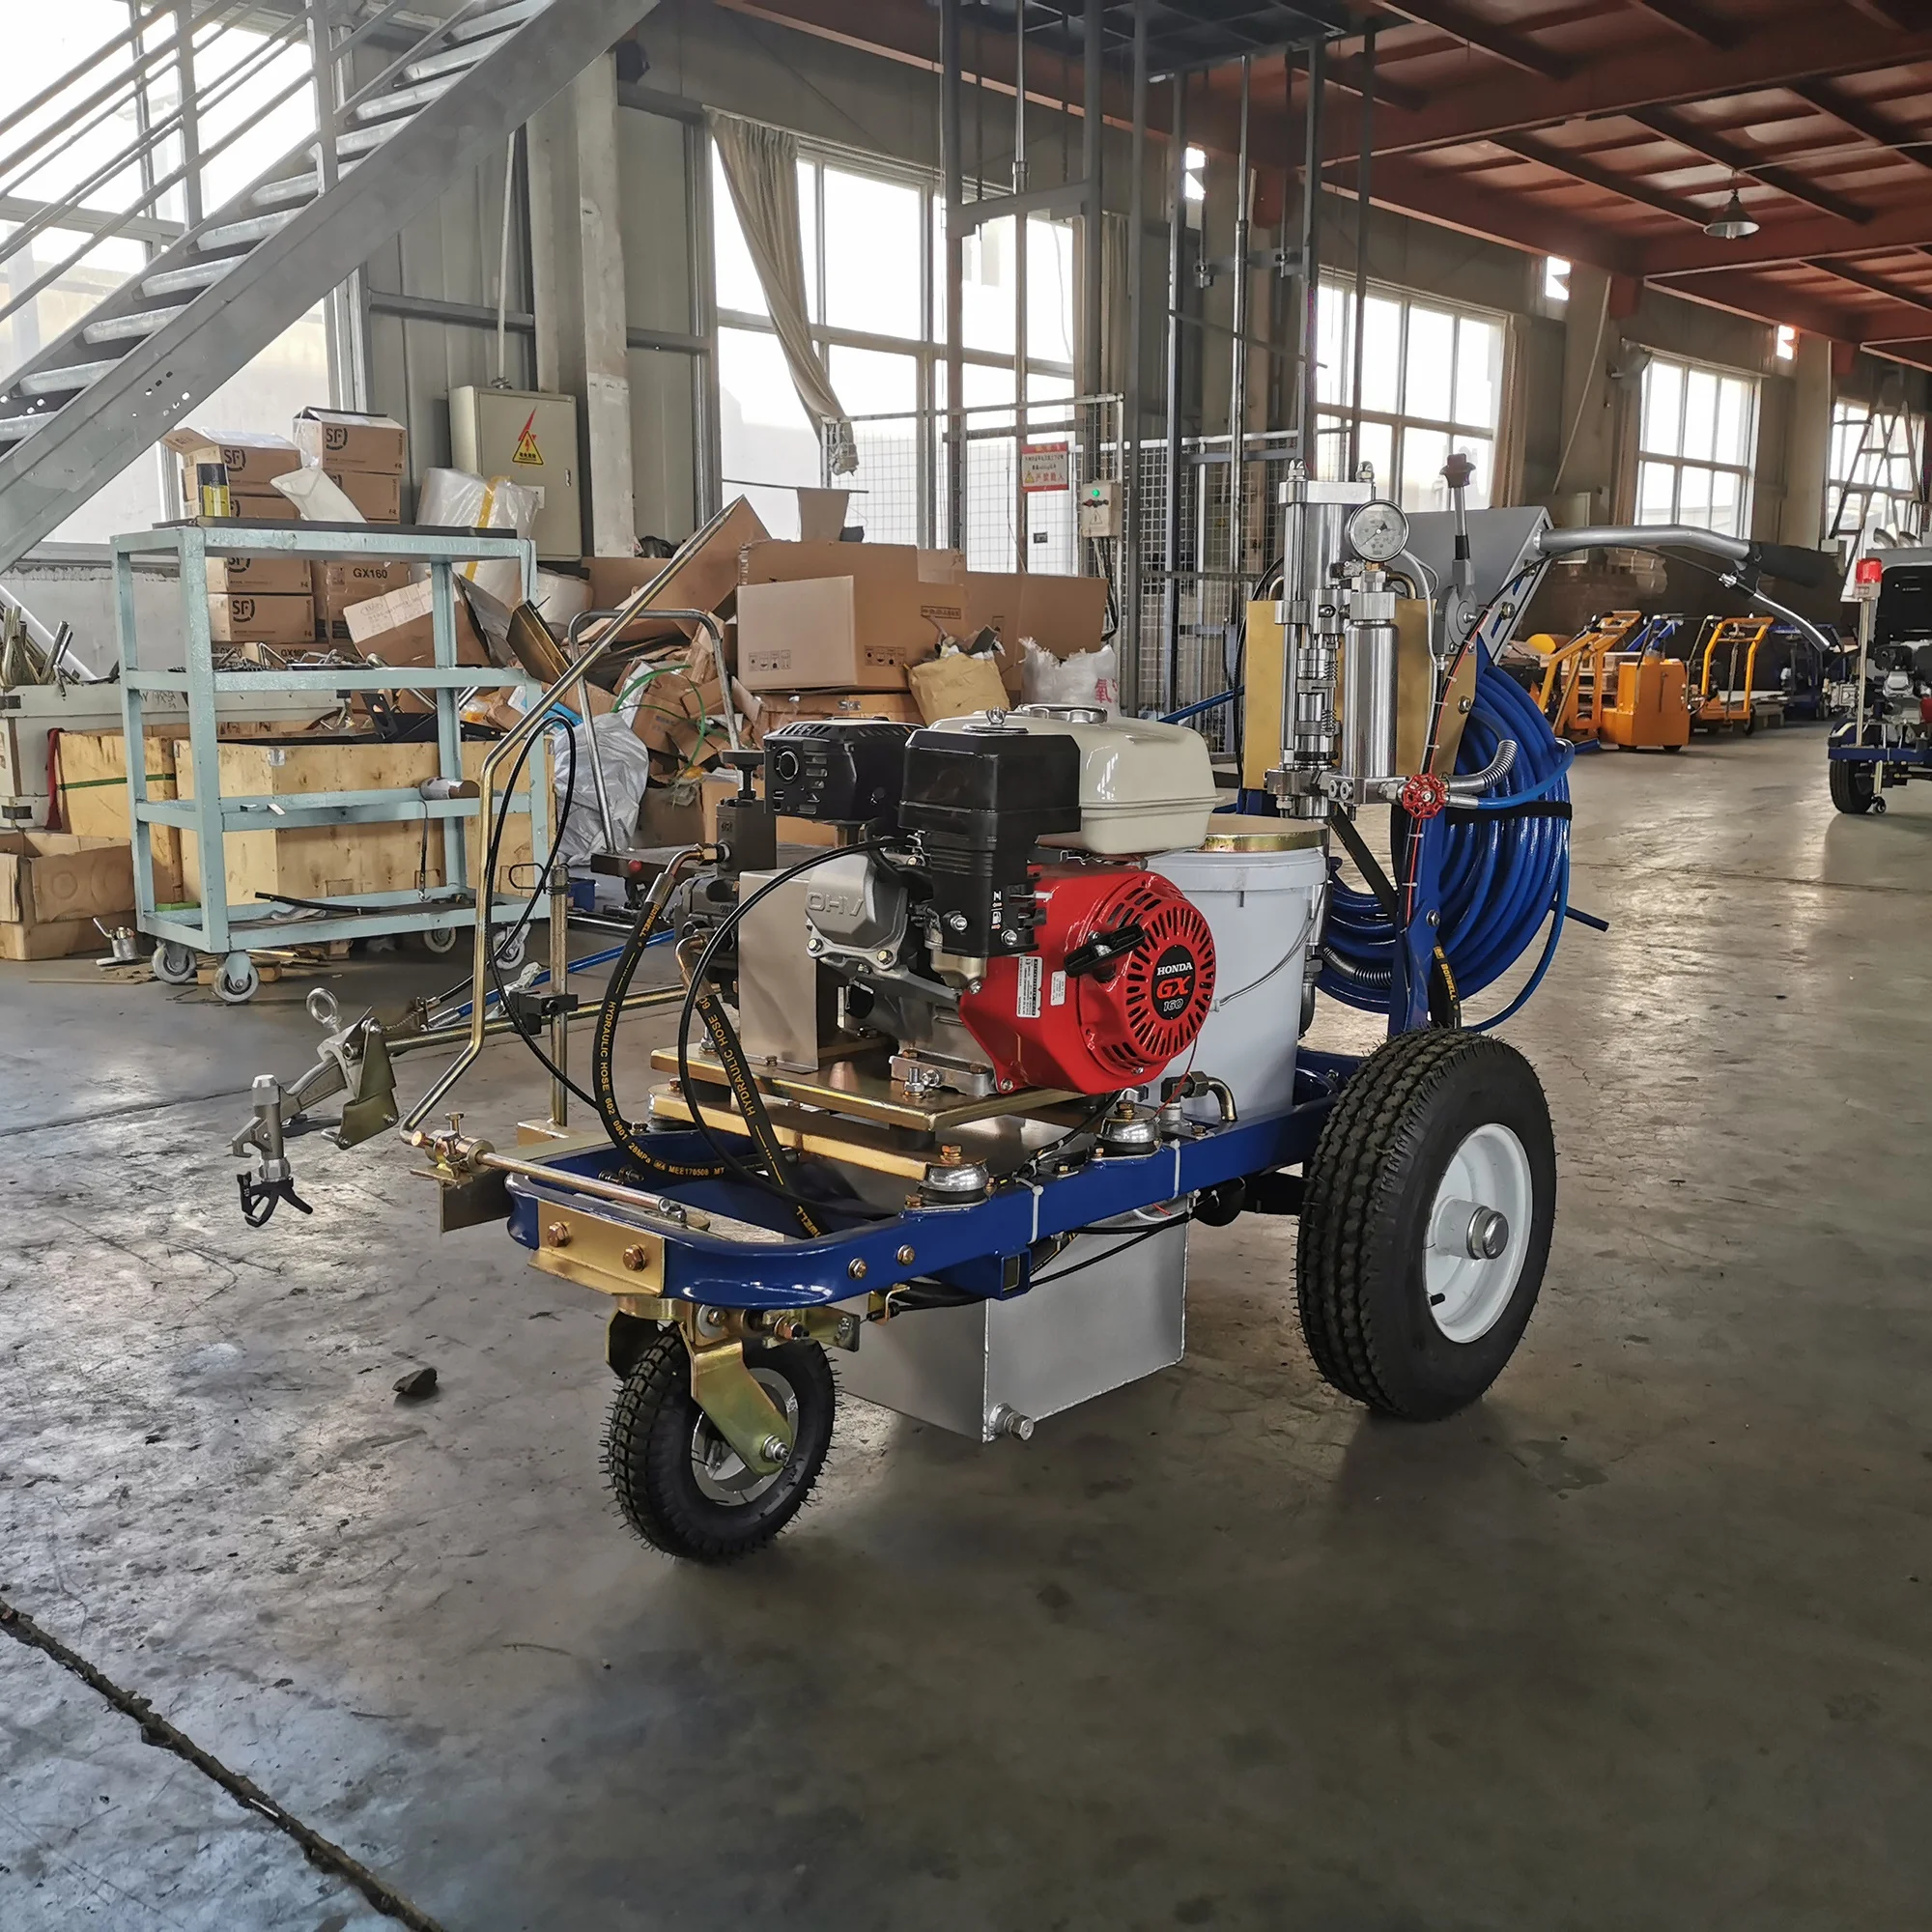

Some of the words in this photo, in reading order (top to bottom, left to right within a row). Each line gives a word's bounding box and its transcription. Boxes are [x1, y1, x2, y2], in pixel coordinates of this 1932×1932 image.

[353, 567, 388, 579] GX160
[1156, 962, 1194, 976] HONDA
[1156, 976, 1191, 999] GX
[1163, 998, 1184, 1012] 160
[600, 1001, 617, 1058] HYDRAULIC
[707, 1014, 728, 1046] HOSE
[600, 1062, 611, 1092] HOSE
[724, 1049, 756, 1117] HYDRAULIC
[605, 1097, 615, 1116] 602
[628, 1142, 651, 1164] 28MPa
